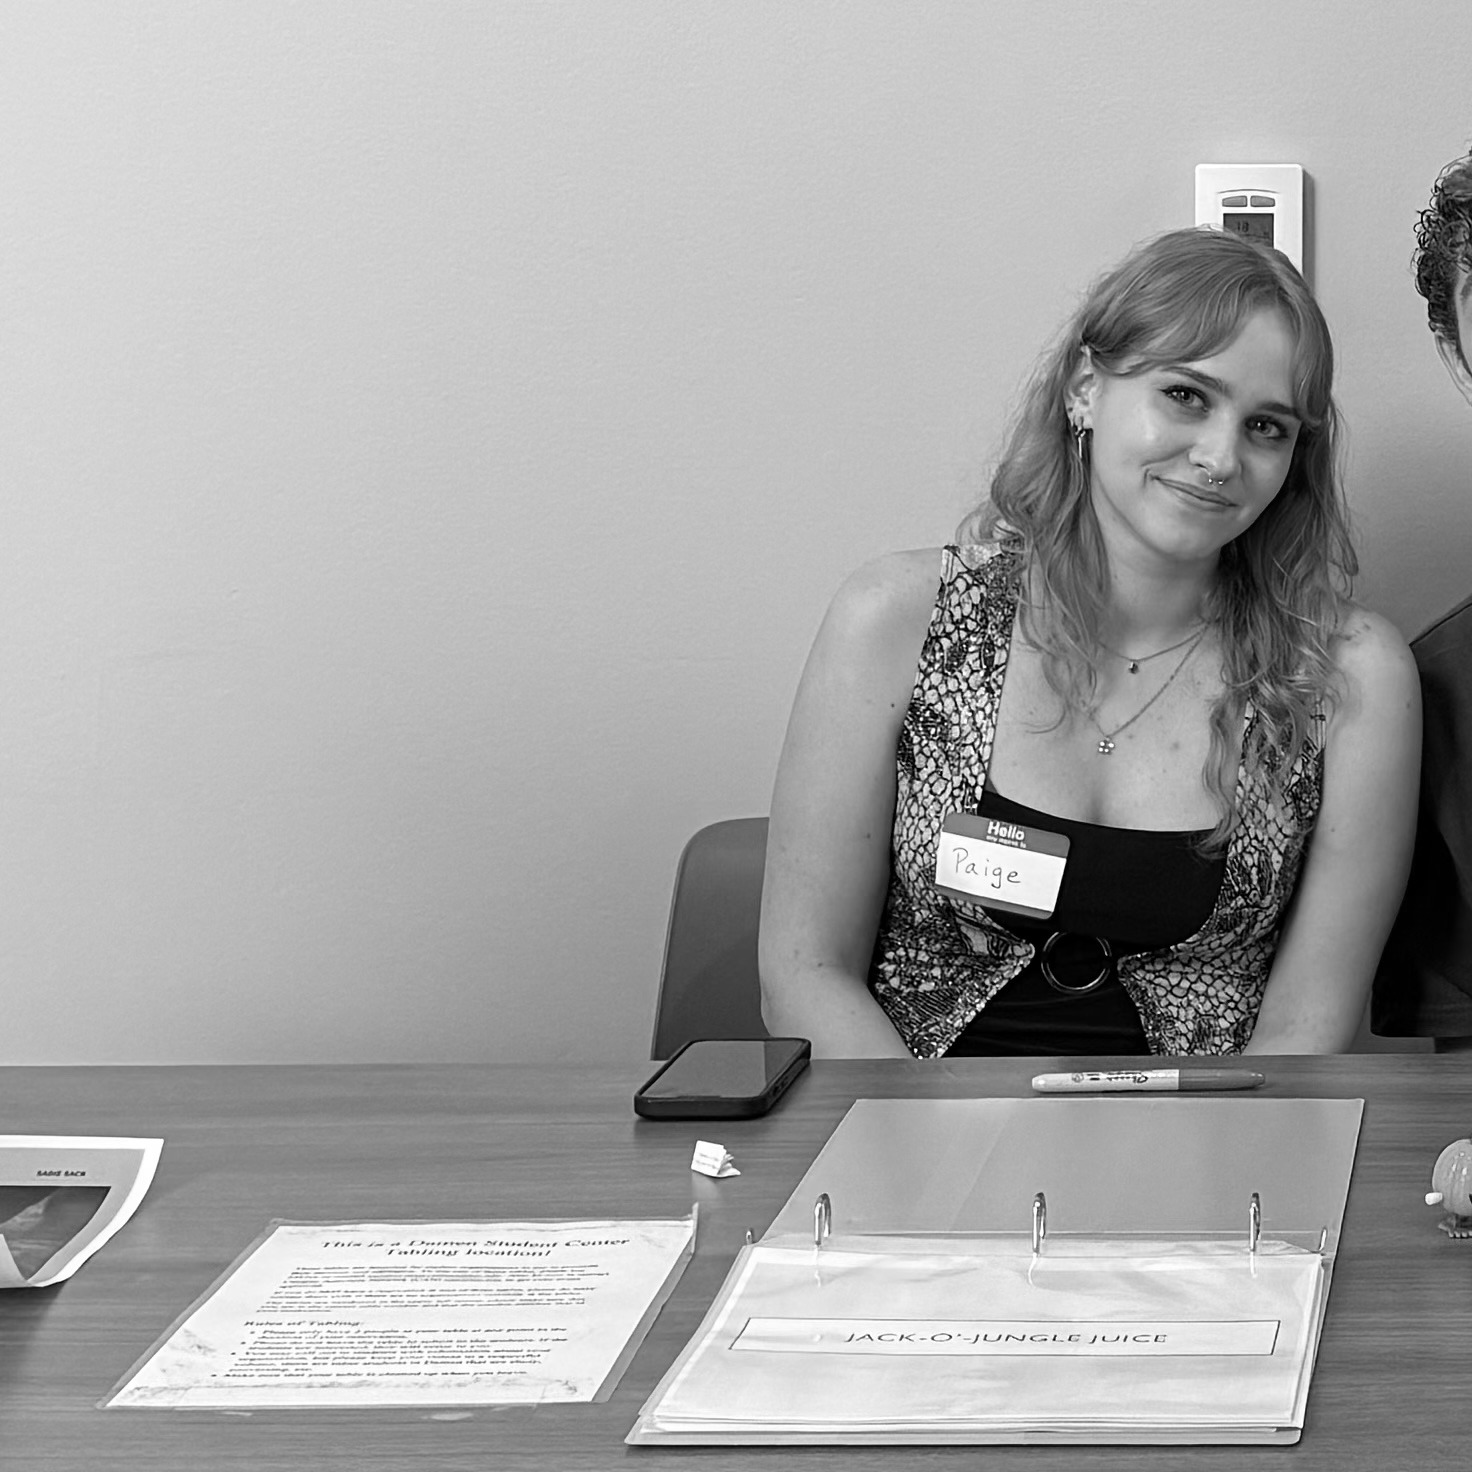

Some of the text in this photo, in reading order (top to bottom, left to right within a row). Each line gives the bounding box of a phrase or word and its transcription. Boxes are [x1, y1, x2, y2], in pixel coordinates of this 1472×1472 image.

[987, 821, 1025, 841] Hello
[952, 847, 1021, 889] Paige
[323, 1240, 362, 1248] This
[484, 1240, 558, 1248] Student
[564, 1239, 630, 1247] Center
[387, 1248, 551, 1257] Tabling location!
[844, 1332, 1168, 1345] JACK-O'-JUNGLE JUICE
